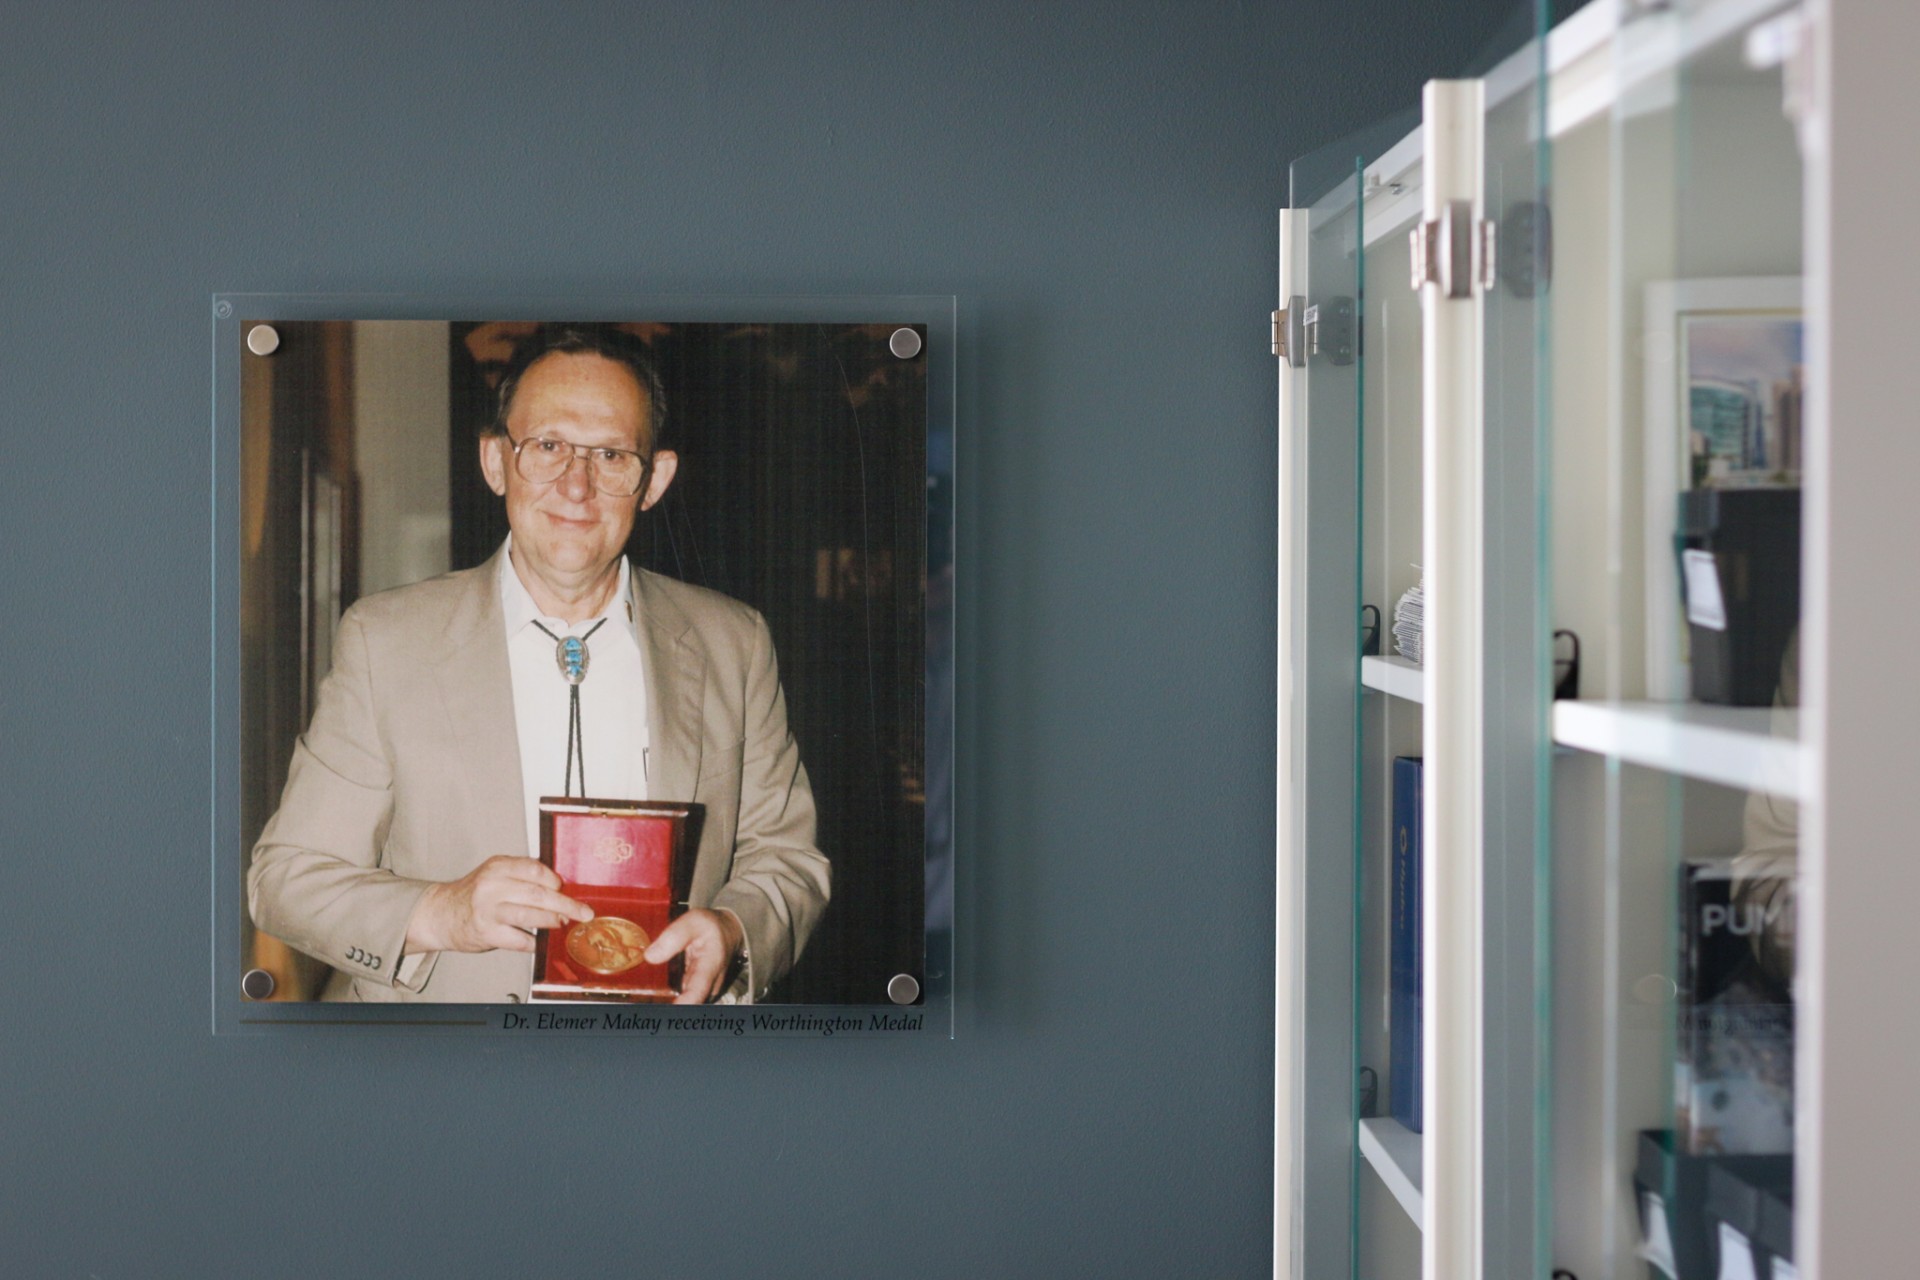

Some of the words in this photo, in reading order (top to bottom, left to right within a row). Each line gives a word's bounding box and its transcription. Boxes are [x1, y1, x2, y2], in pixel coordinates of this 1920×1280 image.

[503, 1012, 530, 1030] Dr.
[537, 1012, 597, 1030] Elemer
[602, 1013, 661, 1035] Makay
[667, 1014, 746, 1036] receiving
[752, 1014, 862, 1036] Worthington
[869, 1014, 924, 1031] Medal
